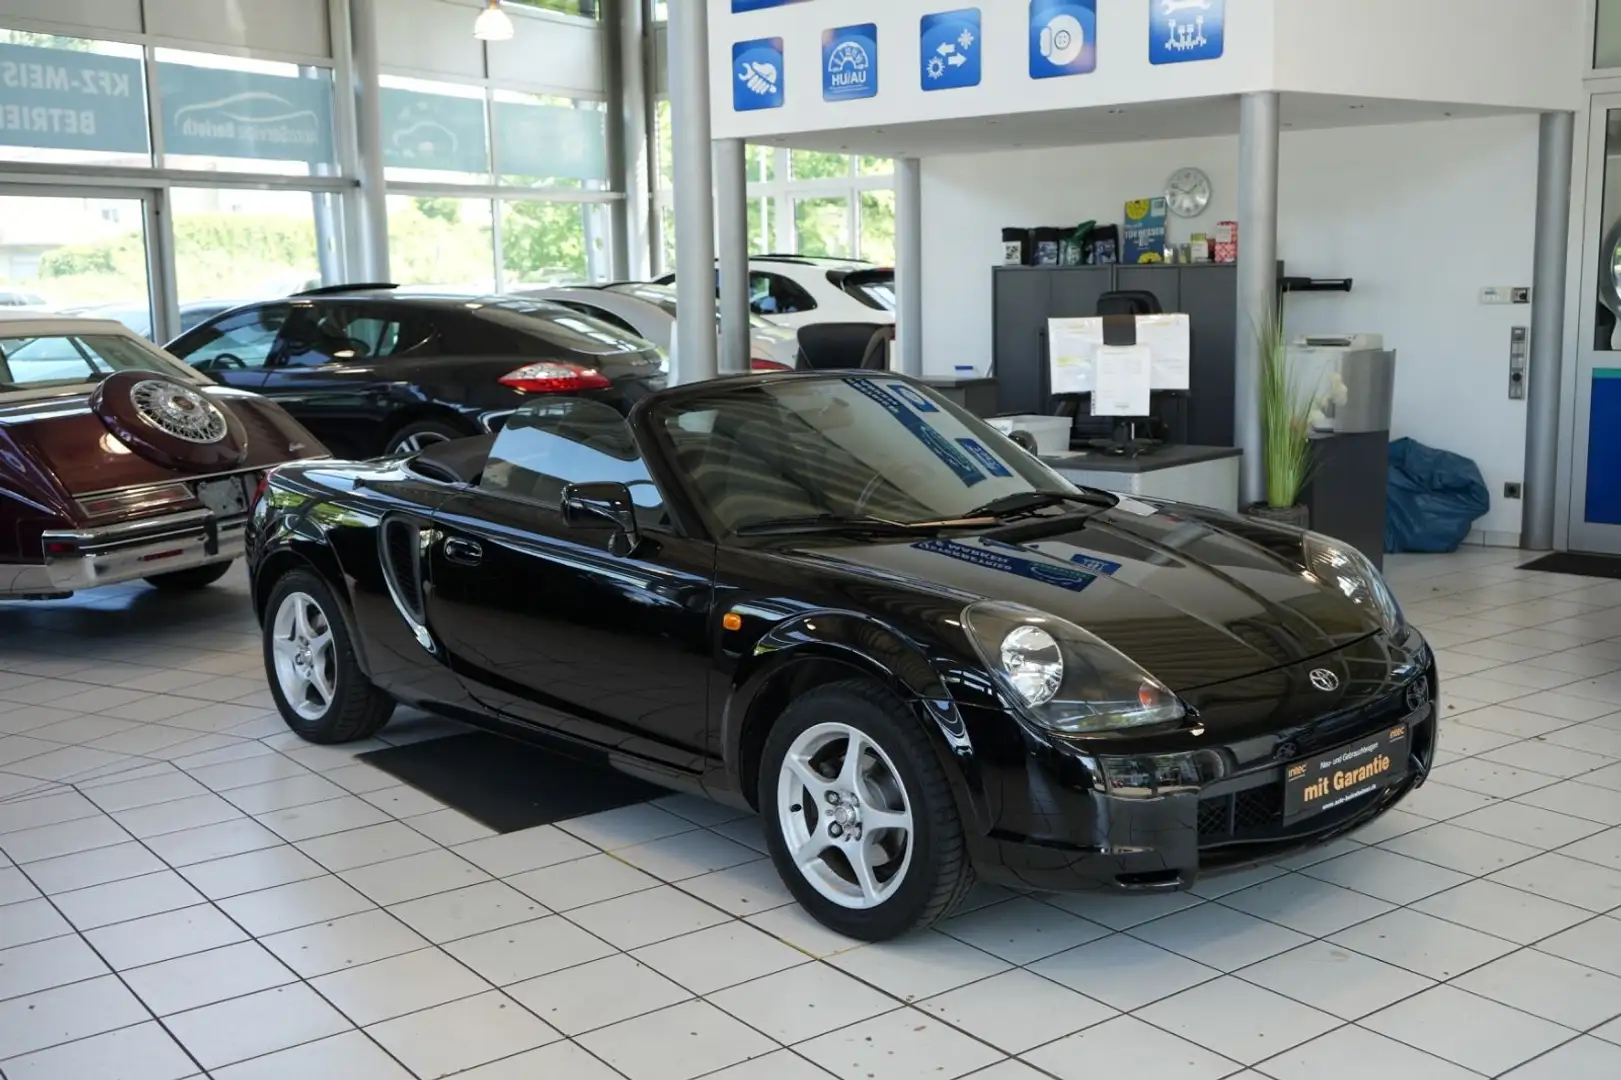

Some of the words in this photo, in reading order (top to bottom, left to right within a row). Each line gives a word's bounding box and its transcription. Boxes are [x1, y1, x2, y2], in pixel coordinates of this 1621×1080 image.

[832, 71, 866, 86] HU/AU
[1304, 778, 1329, 802] mit
[1333, 754, 1390, 791] Garantie
